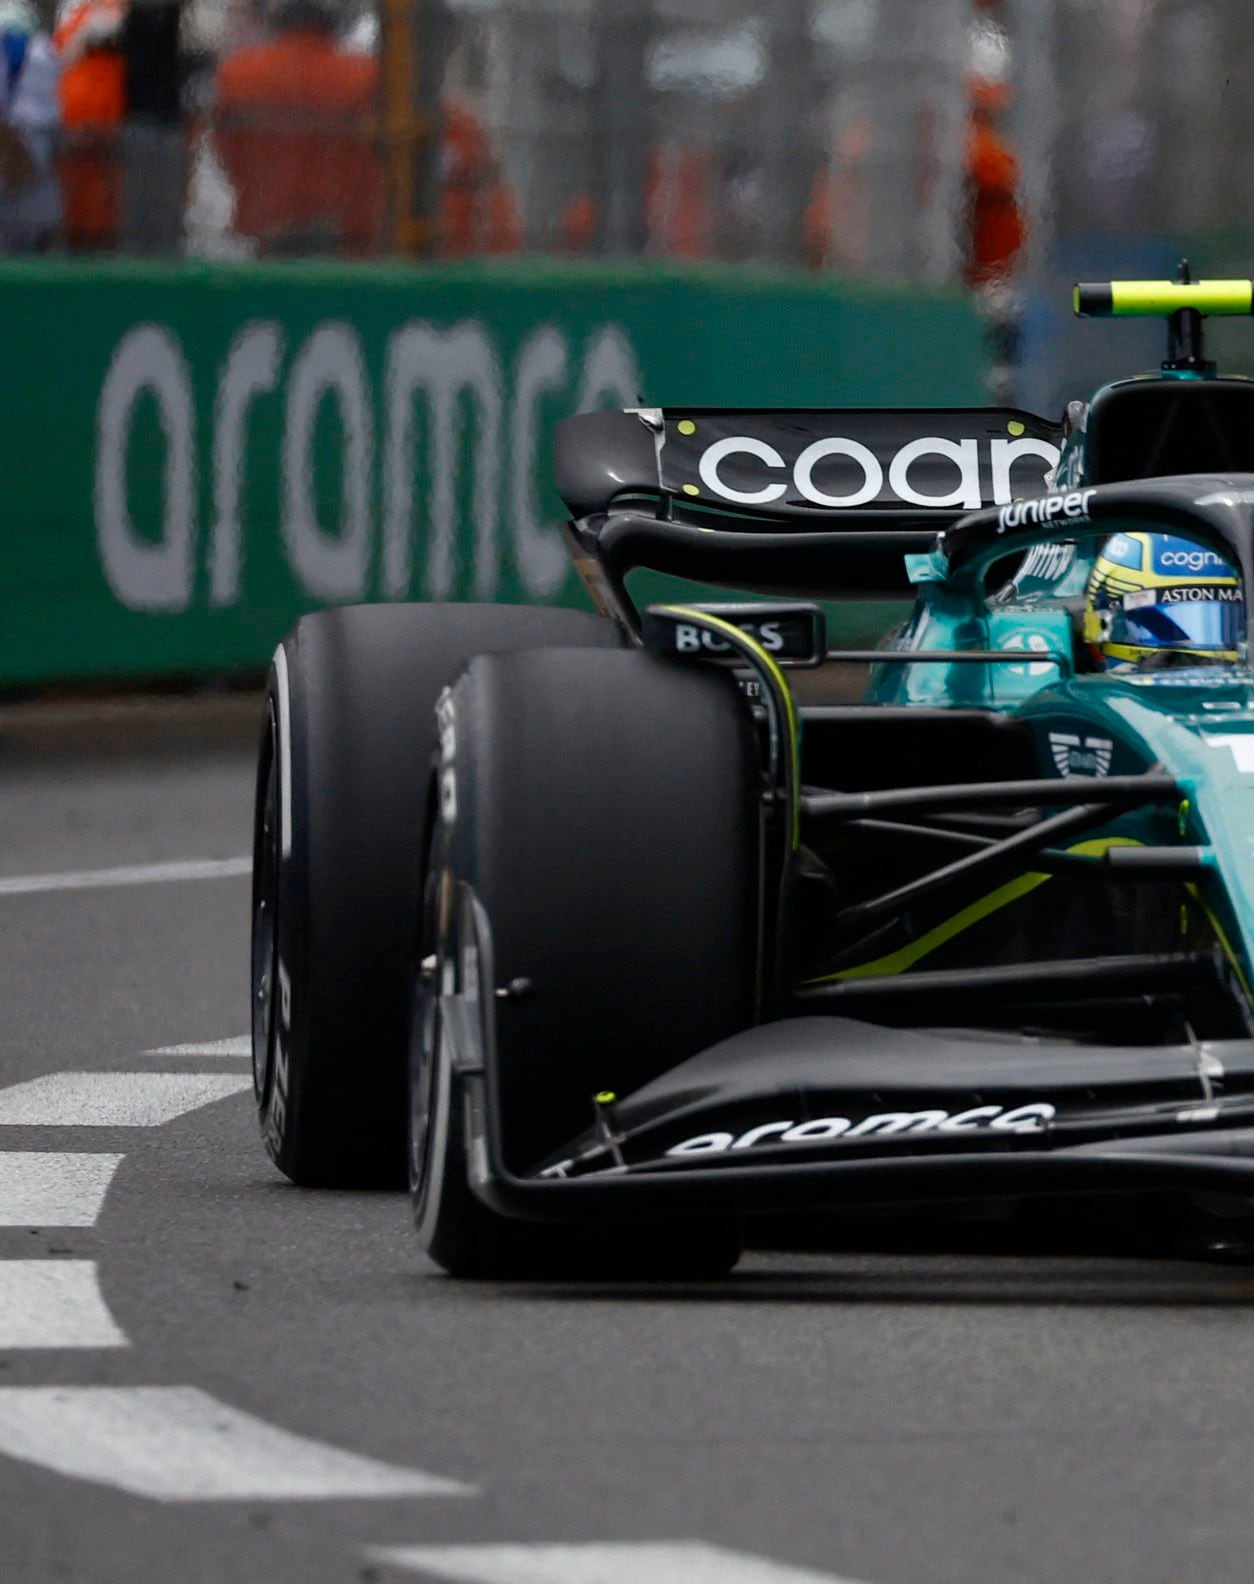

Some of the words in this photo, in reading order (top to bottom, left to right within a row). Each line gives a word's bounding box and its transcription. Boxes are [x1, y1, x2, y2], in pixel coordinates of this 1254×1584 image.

[1161, 588, 1215, 603] ASTON
[676, 622, 784, 652] BOS
[666, 1102, 1056, 1156] aramco
